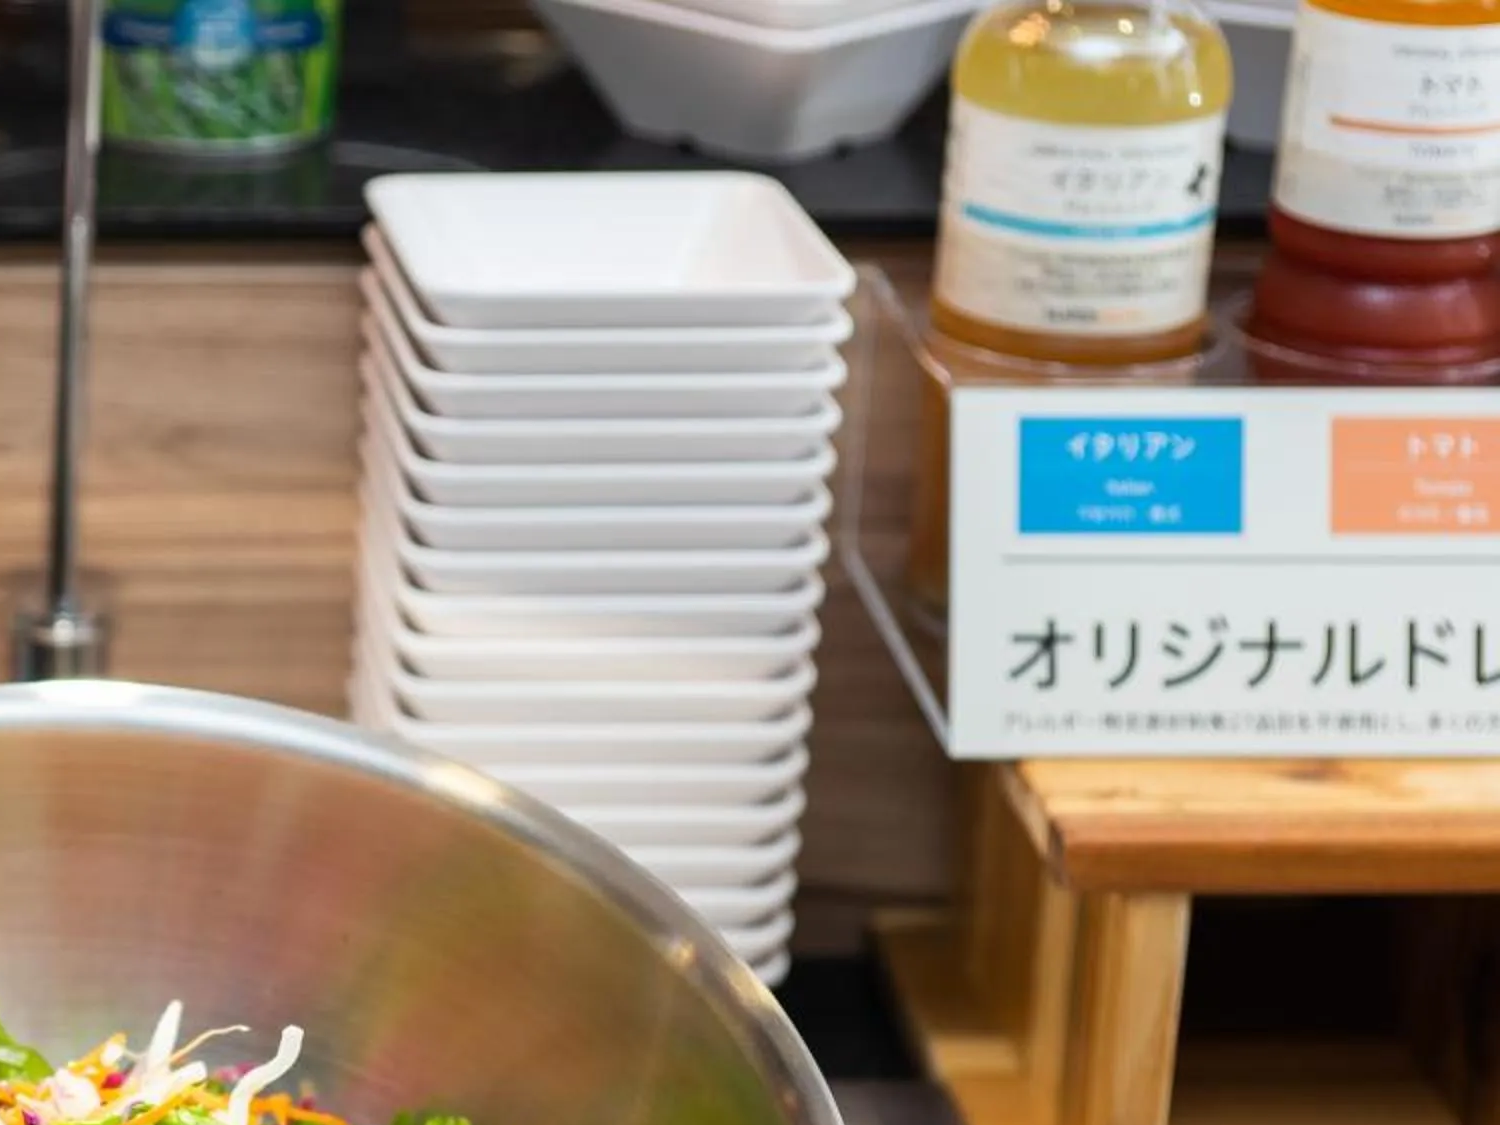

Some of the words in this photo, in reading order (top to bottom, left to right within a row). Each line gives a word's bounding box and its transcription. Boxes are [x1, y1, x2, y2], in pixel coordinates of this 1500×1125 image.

[1065, 431, 1197, 461] イタリアン
